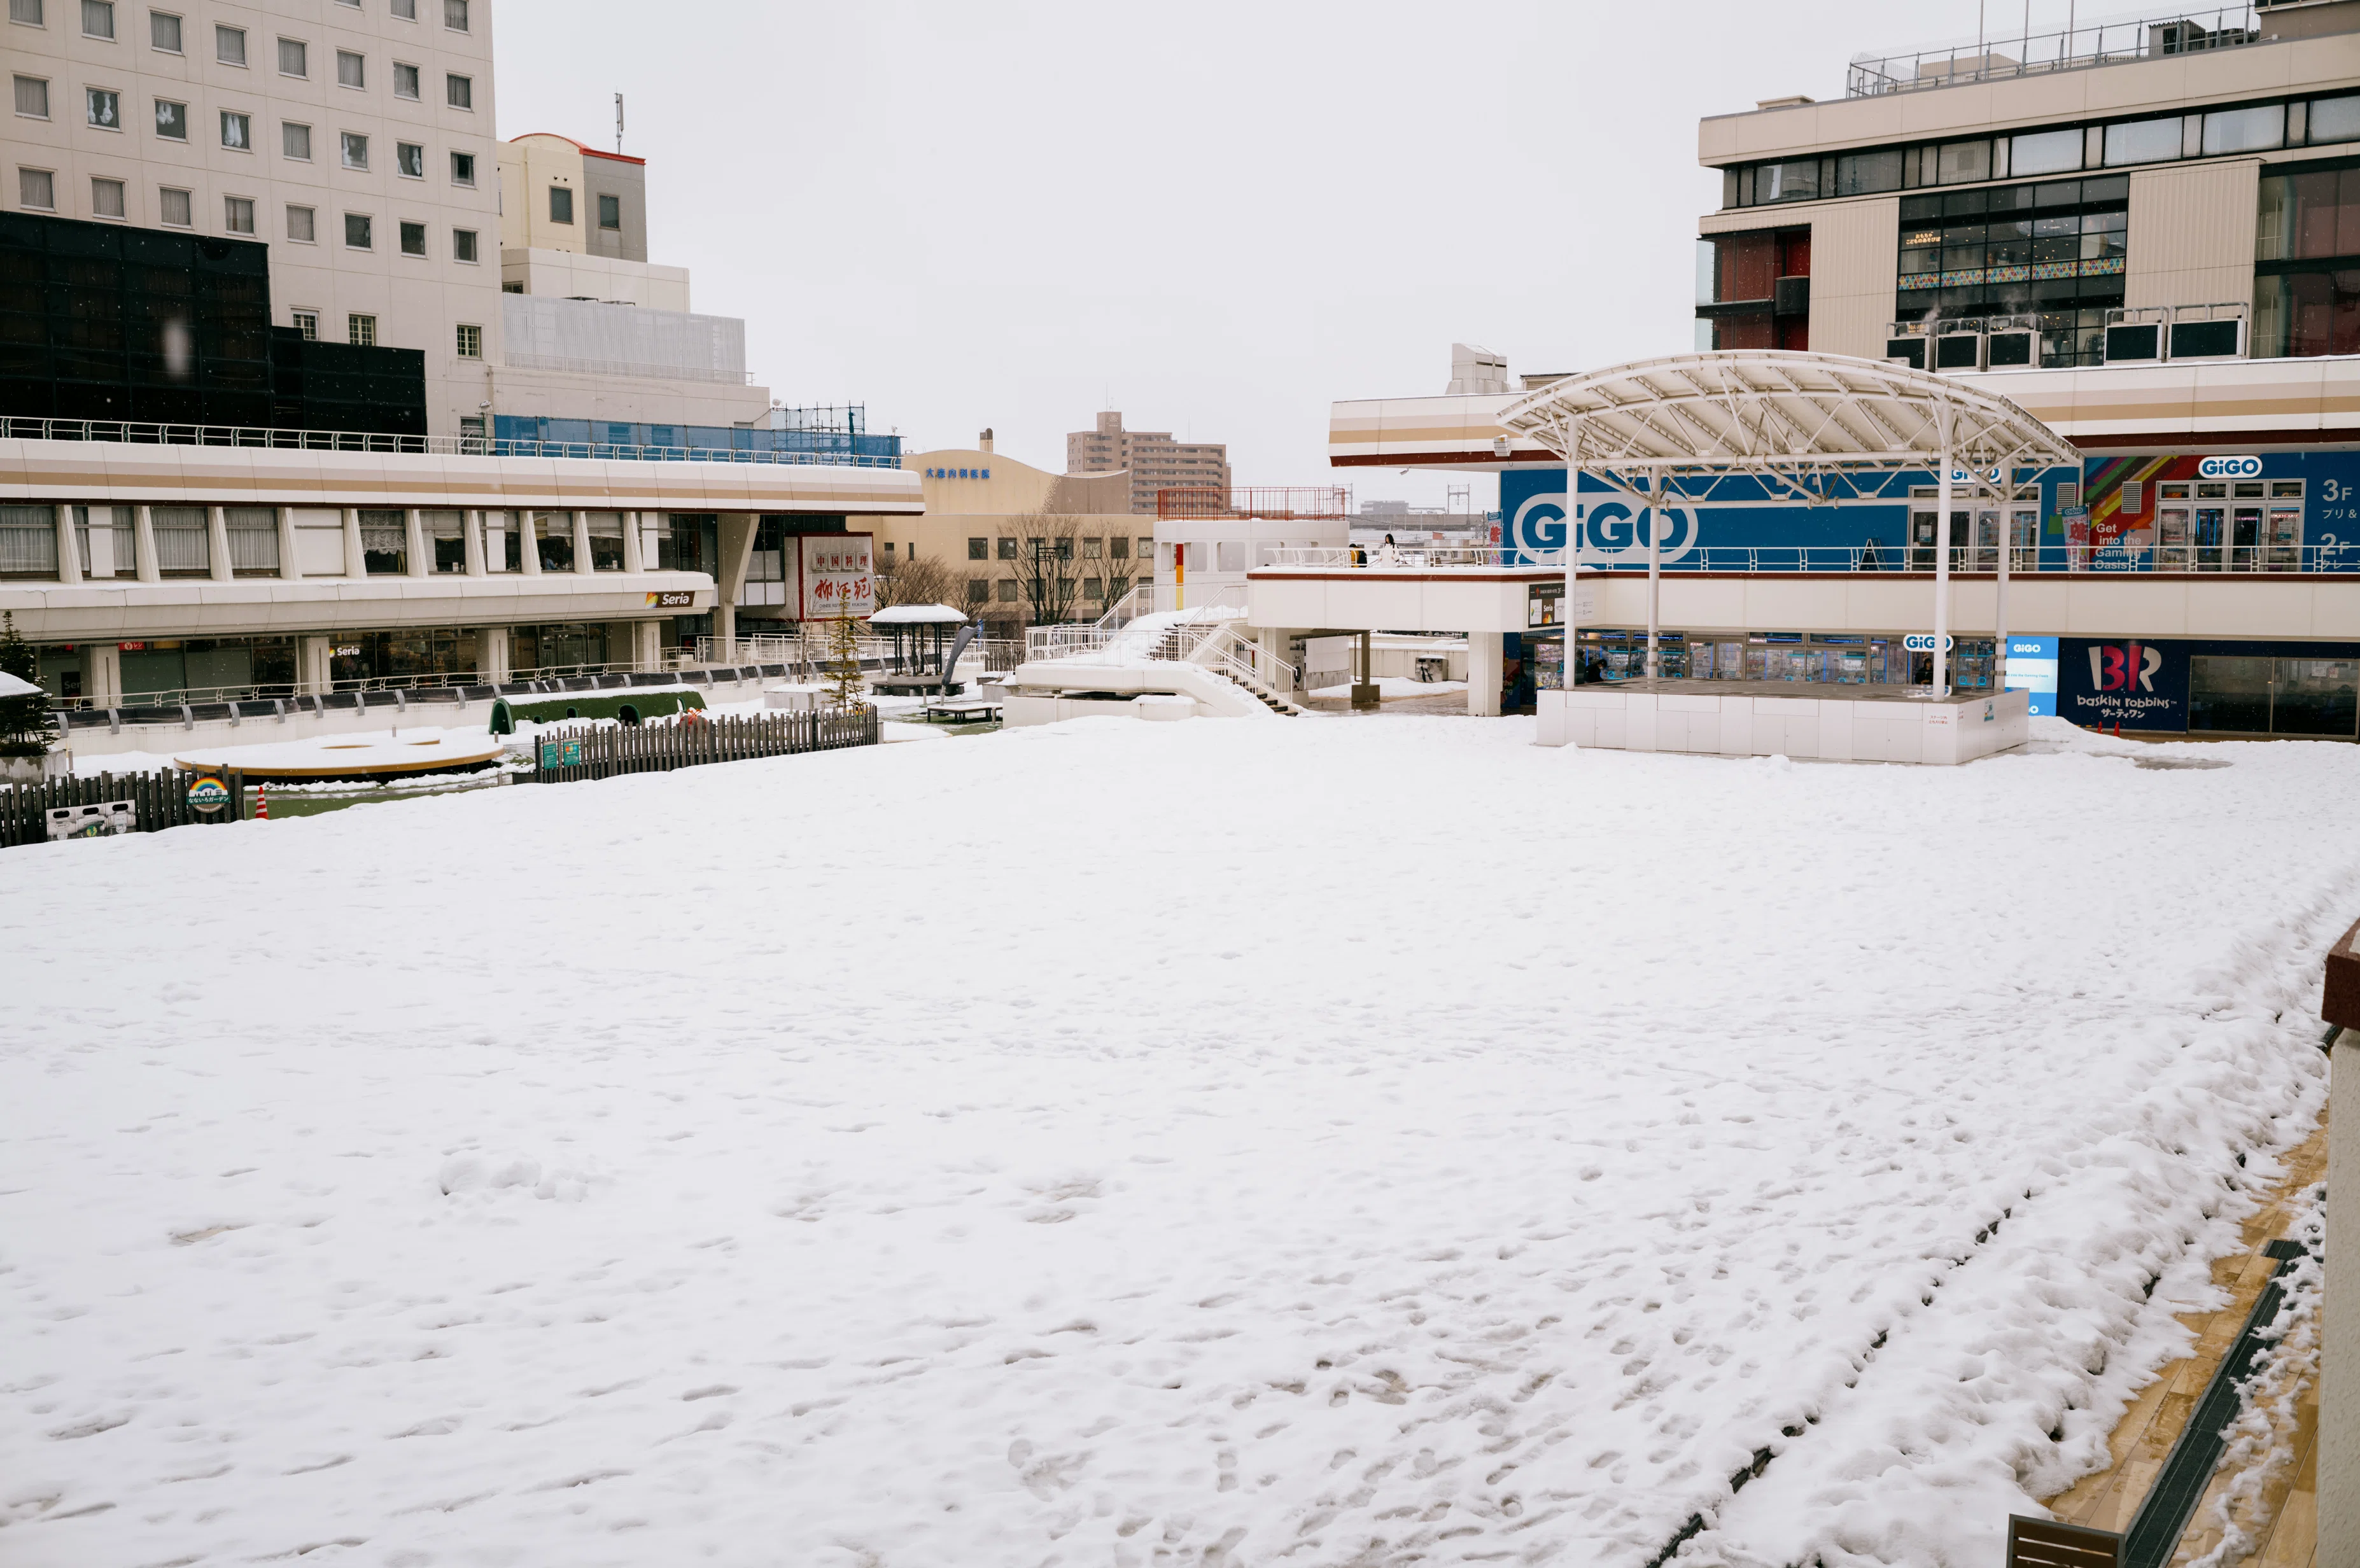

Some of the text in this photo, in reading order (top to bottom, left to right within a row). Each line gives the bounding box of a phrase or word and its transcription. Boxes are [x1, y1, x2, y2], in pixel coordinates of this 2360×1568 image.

[2202, 459, 2259, 475] GiGO
[926, 468, 990, 479] 大森内科医院
[2322, 479, 2352, 501] 3F
[2322, 508, 2343, 519] プリ
[2096, 523, 2117, 533] Get
[2099, 535, 2141, 545] into the
[2320, 533, 2350, 555] 2F
[2095, 547, 2141, 559] Gaming
[817, 556, 867, 566] 中国料理
[2095, 559, 2127, 570] Oasis
[663, 592, 690, 605] Seria
[337, 646, 360, 656] Seria
[2013, 644, 2041, 653] GiGO
[2088, 645, 2162, 692] BR
[2101, 708, 2145, 718] サーティワン
